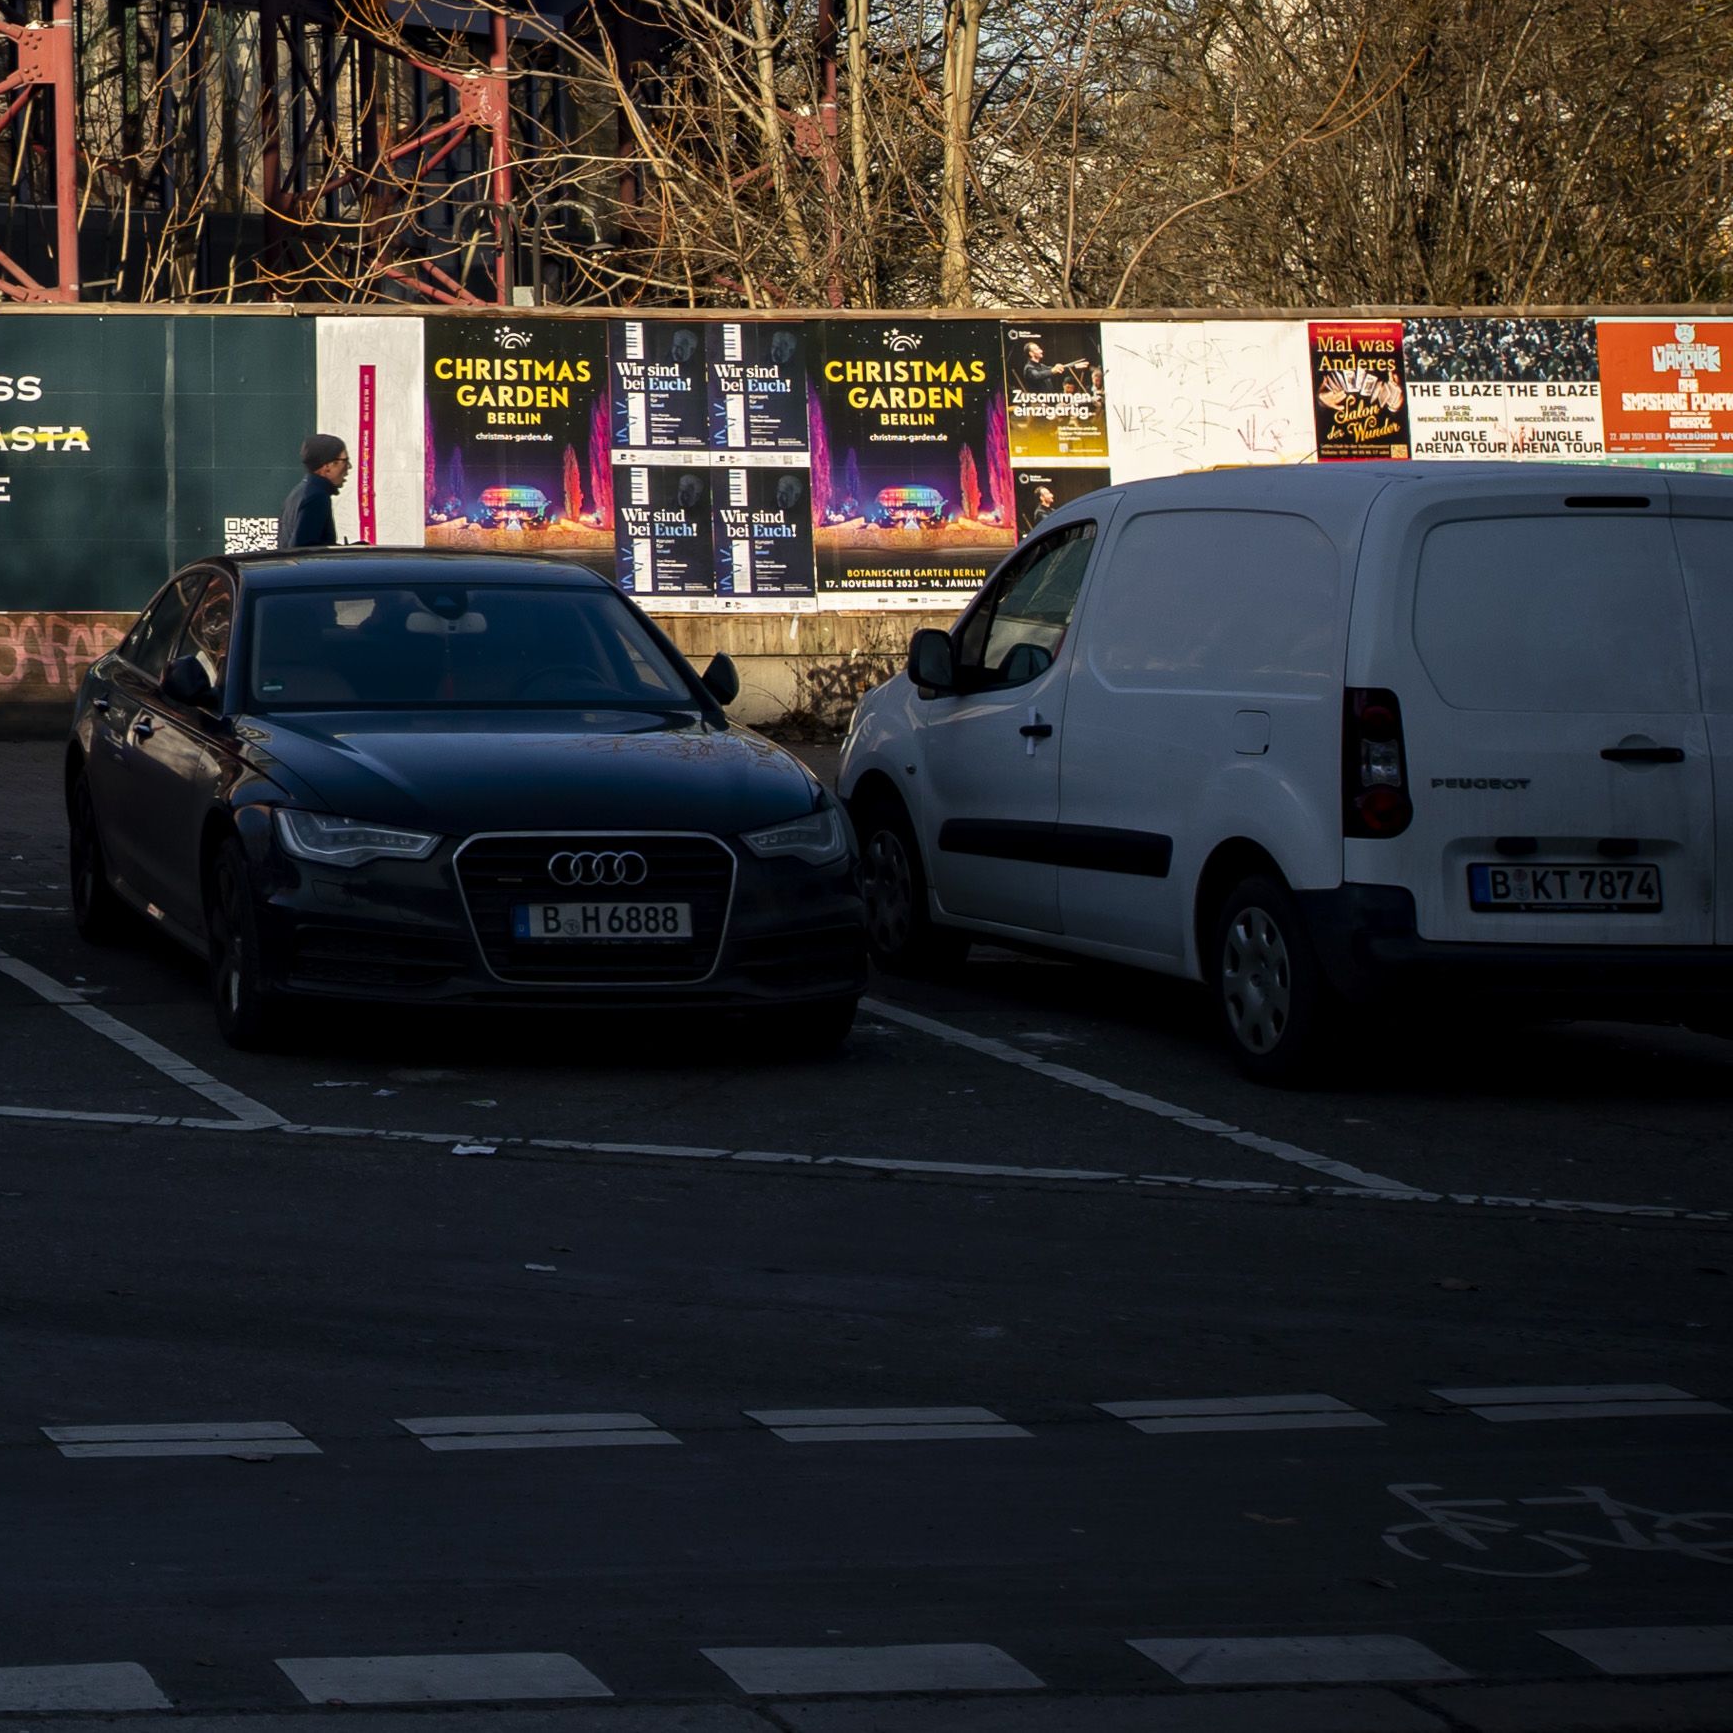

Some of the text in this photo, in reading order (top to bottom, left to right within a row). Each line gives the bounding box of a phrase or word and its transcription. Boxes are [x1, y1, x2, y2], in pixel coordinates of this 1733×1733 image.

[1316, 334, 1395, 352] Mal was
[434, 357, 592, 382] CHRISTMAS
[616, 362, 680, 377] Wir sind
[1318, 353, 1396, 371] Anderes
[714, 363, 780, 379] Wir sind
[824, 360, 986, 383] CHRISTMAS
[622, 377, 692, 391] bei Euch!
[720, 378, 792, 393] bei Euch!
[1409, 384, 1503, 397] THE BLAZE
[1506, 384, 1599, 397] THE BLAZE
[456, 385, 569, 408] GARDEN
[848, 386, 964, 409] GARDEN
[1621, 392, 1688, 411] SMASHING
[1334, 394, 1380, 424] Salon
[486, 412, 542, 425] BERLIN
[880, 413, 935, 426] BERLIN
[1327, 415, 1401, 443] der Wunder
[1431, 430, 1487, 442] JUNGLE
[1528, 430, 1583, 442] JUNGLE
[475, 432, 554, 443] christmas-garden.de
[869, 433, 948, 443] christmas-garden.de
[1414, 442, 1507, 454] ARENA TOUR
[1511, 442, 1603, 454] ARENA TOUR
[621, 507, 686, 523] Wir sind
[720, 509, 785, 524] Wir sind
[627, 523, 698, 537] bei Euch!
[726, 523, 797, 538] bei Euch!
[847, 568, 986, 577] BOTANISCHER GARTEN BERLIN
[841, 580, 894, 588] NOVEMBER
[896, 580, 919, 588] 2023
[945, 580, 984, 588] JANUAR
[1431, 778, 1531, 790] PEUGEOT
[1492, 869, 1656, 901] B KT 7874
[543, 905, 679, 934] B H 6888
